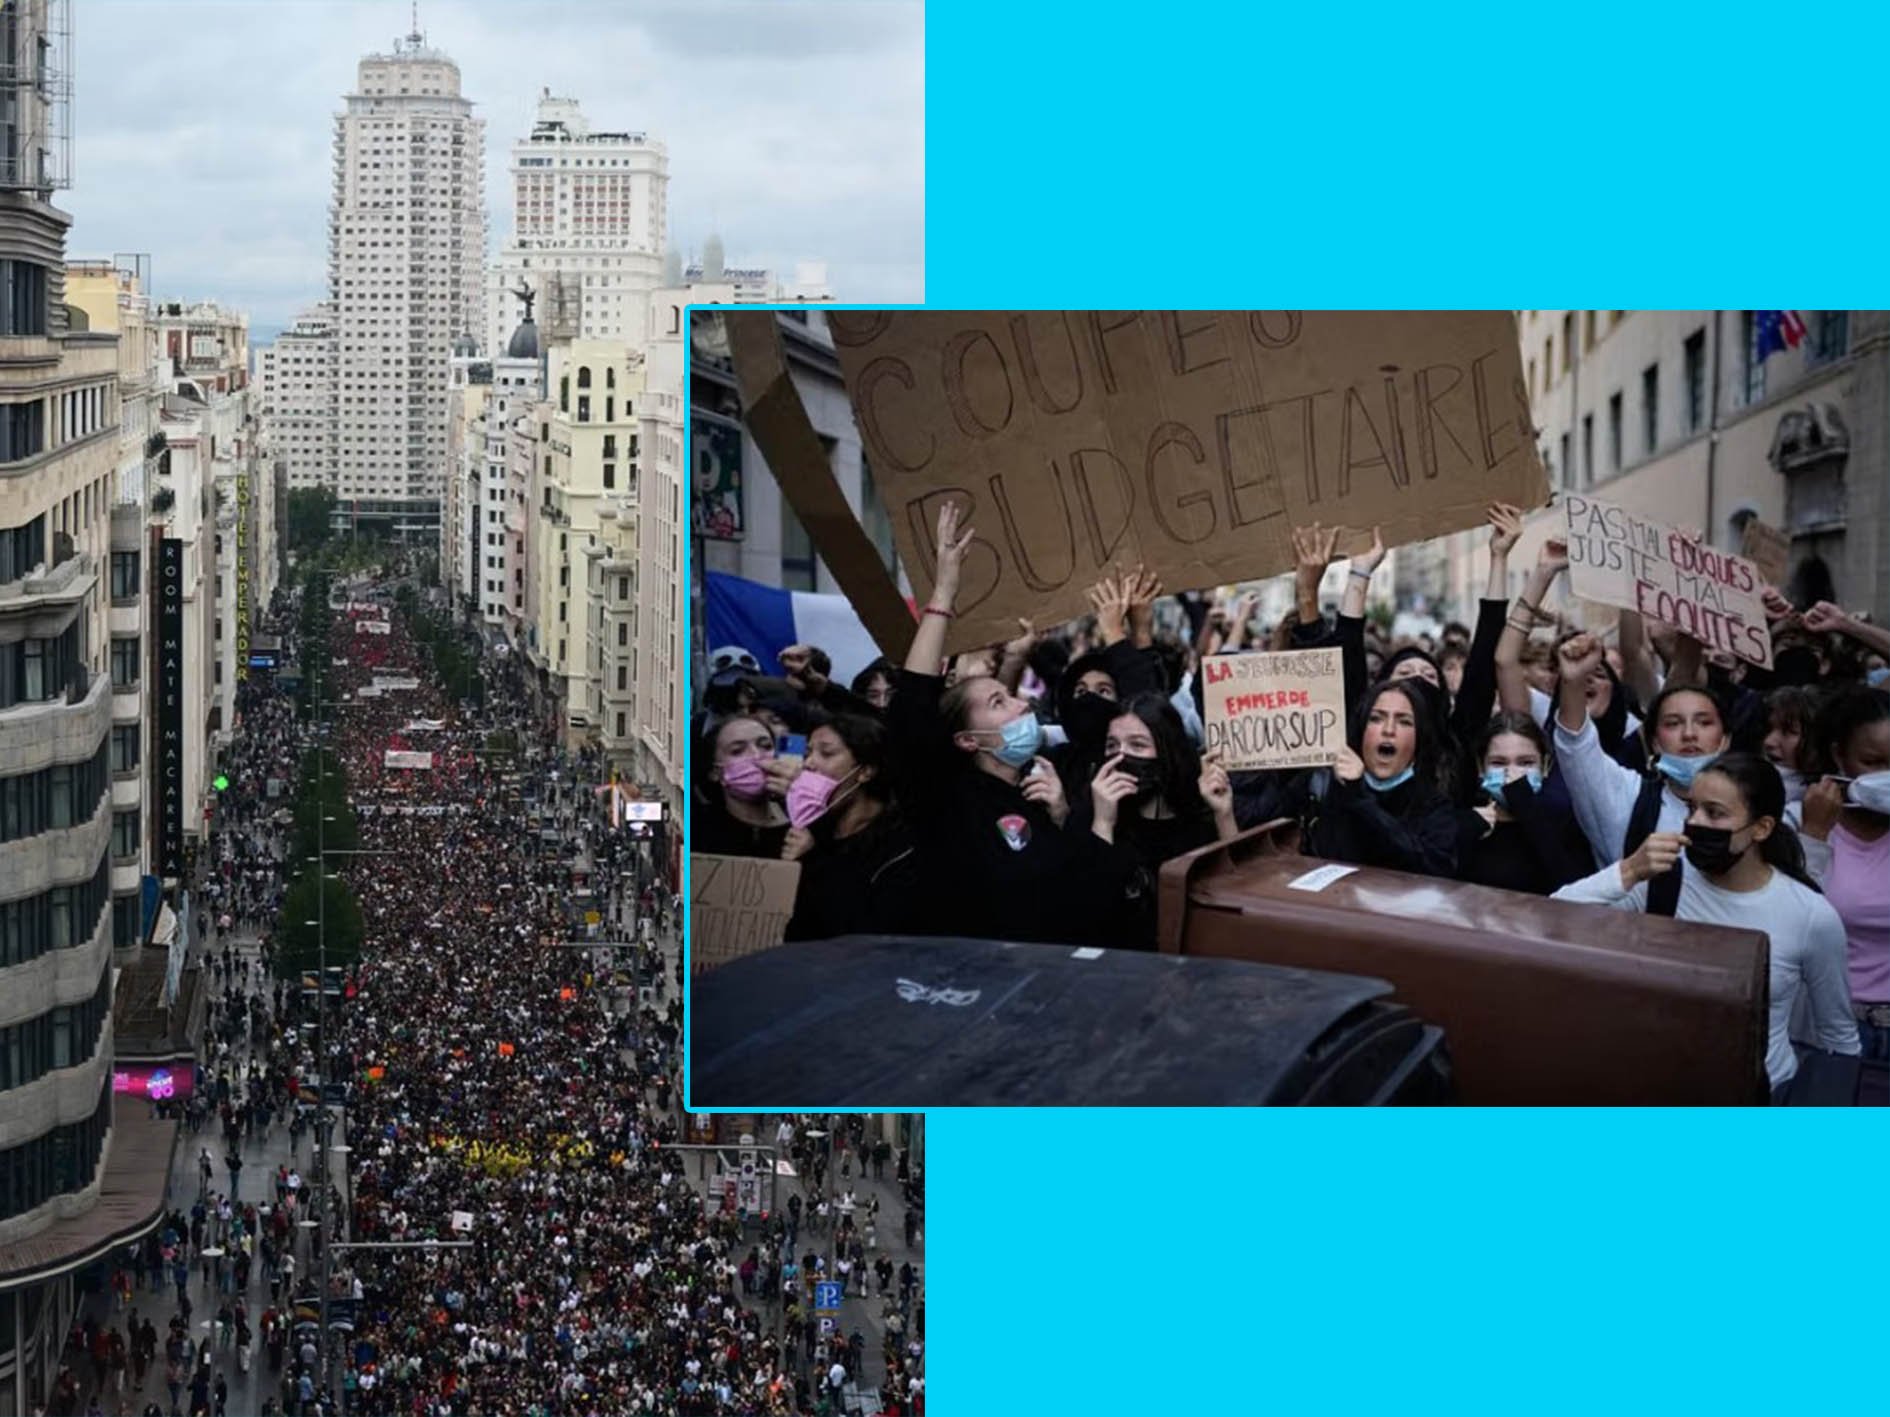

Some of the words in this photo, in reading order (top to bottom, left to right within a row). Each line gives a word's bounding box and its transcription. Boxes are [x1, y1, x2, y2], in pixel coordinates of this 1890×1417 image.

[237, 474, 249, 547] HOTEL
[1566, 497, 1627, 541] PAS
[1628, 517, 1668, 561] MAL
[165, 547, 177, 614] ROOM
[1570, 534, 1660, 588] JUSTE
[1676, 572, 1744, 617] MAL
[237, 556, 249, 680] EMPERADOR
[165, 640, 177, 706] MATE
[1206, 662, 1233, 684] LA
[1226, 690, 1310, 716] EMMERDE
[1207, 709, 1337, 760] PARCOURSUP
[165, 731, 177, 869] MACARENA
[820, 1318, 833, 1333] P
